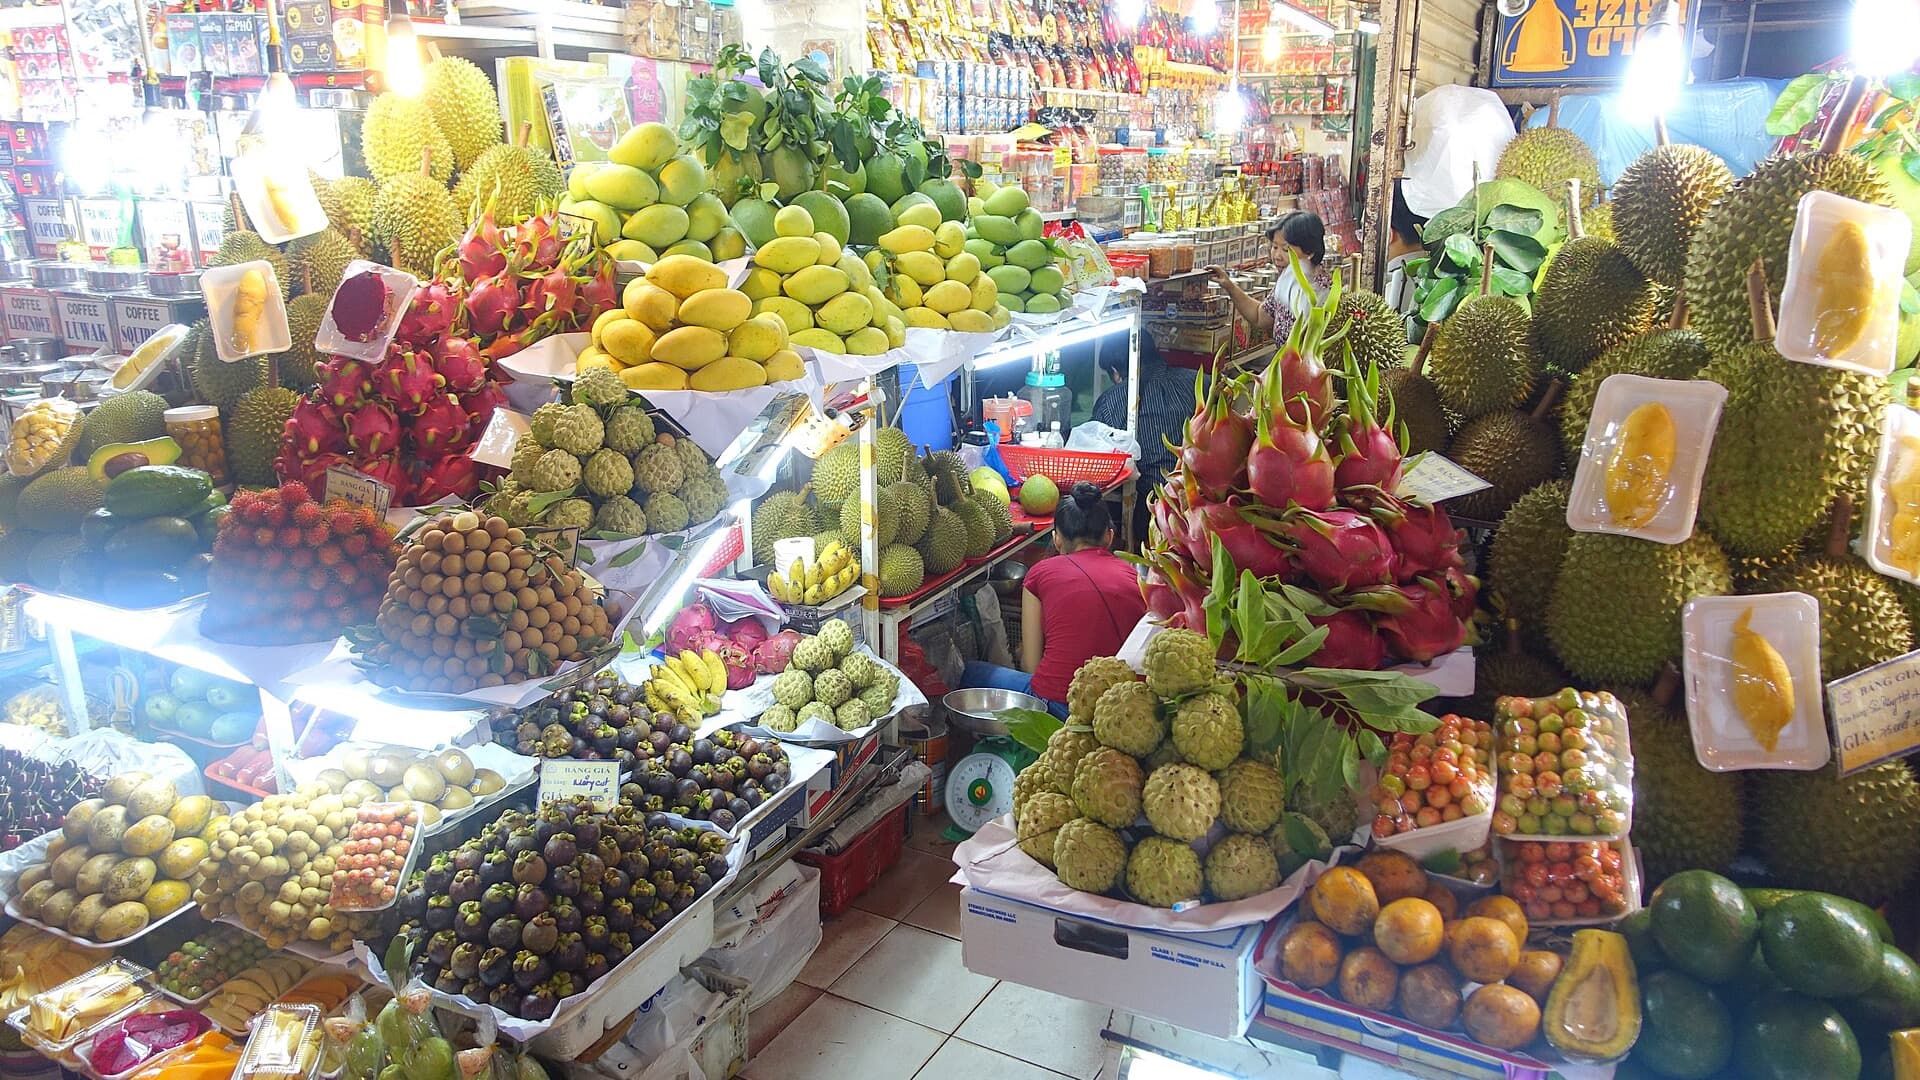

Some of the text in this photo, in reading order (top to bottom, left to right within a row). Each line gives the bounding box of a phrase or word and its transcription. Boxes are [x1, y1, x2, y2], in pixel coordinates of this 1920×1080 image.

[11, 297, 42, 311] COFFEE
[66, 302, 99, 317] COFFEE
[125, 306, 160, 321] COFFEE
[64, 320, 108, 343] LUWAK
[1151, 946, 1170, 955] CLASS
